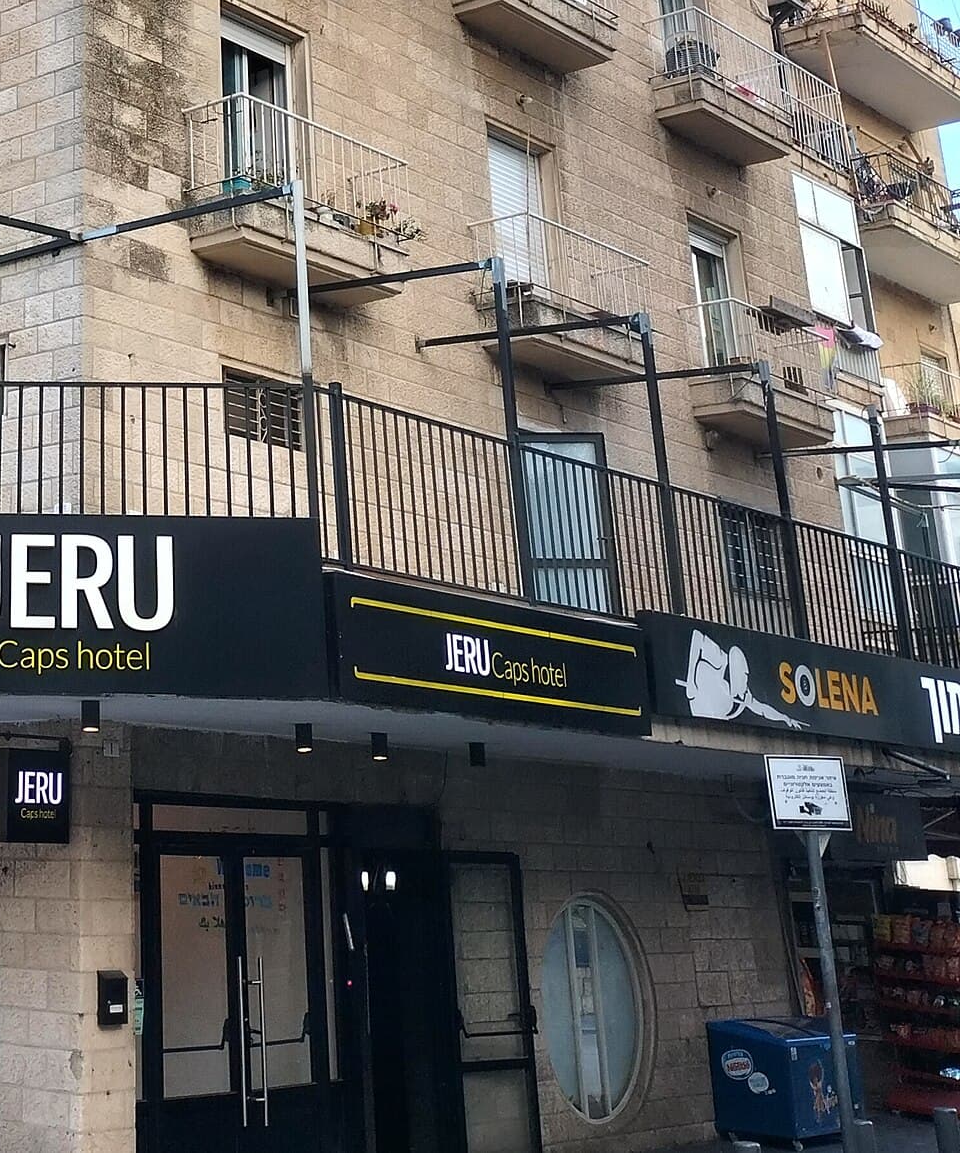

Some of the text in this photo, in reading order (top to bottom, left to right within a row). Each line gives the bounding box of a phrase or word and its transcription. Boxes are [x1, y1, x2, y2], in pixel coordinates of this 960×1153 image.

[77, 640, 150, 670] hotel
[445, 632, 567, 688] JERU Caps hotel
[778, 661, 880, 717] SOLENA
[14, 770, 63, 805] JERU
[20, 807, 57, 820] Caps hotel
